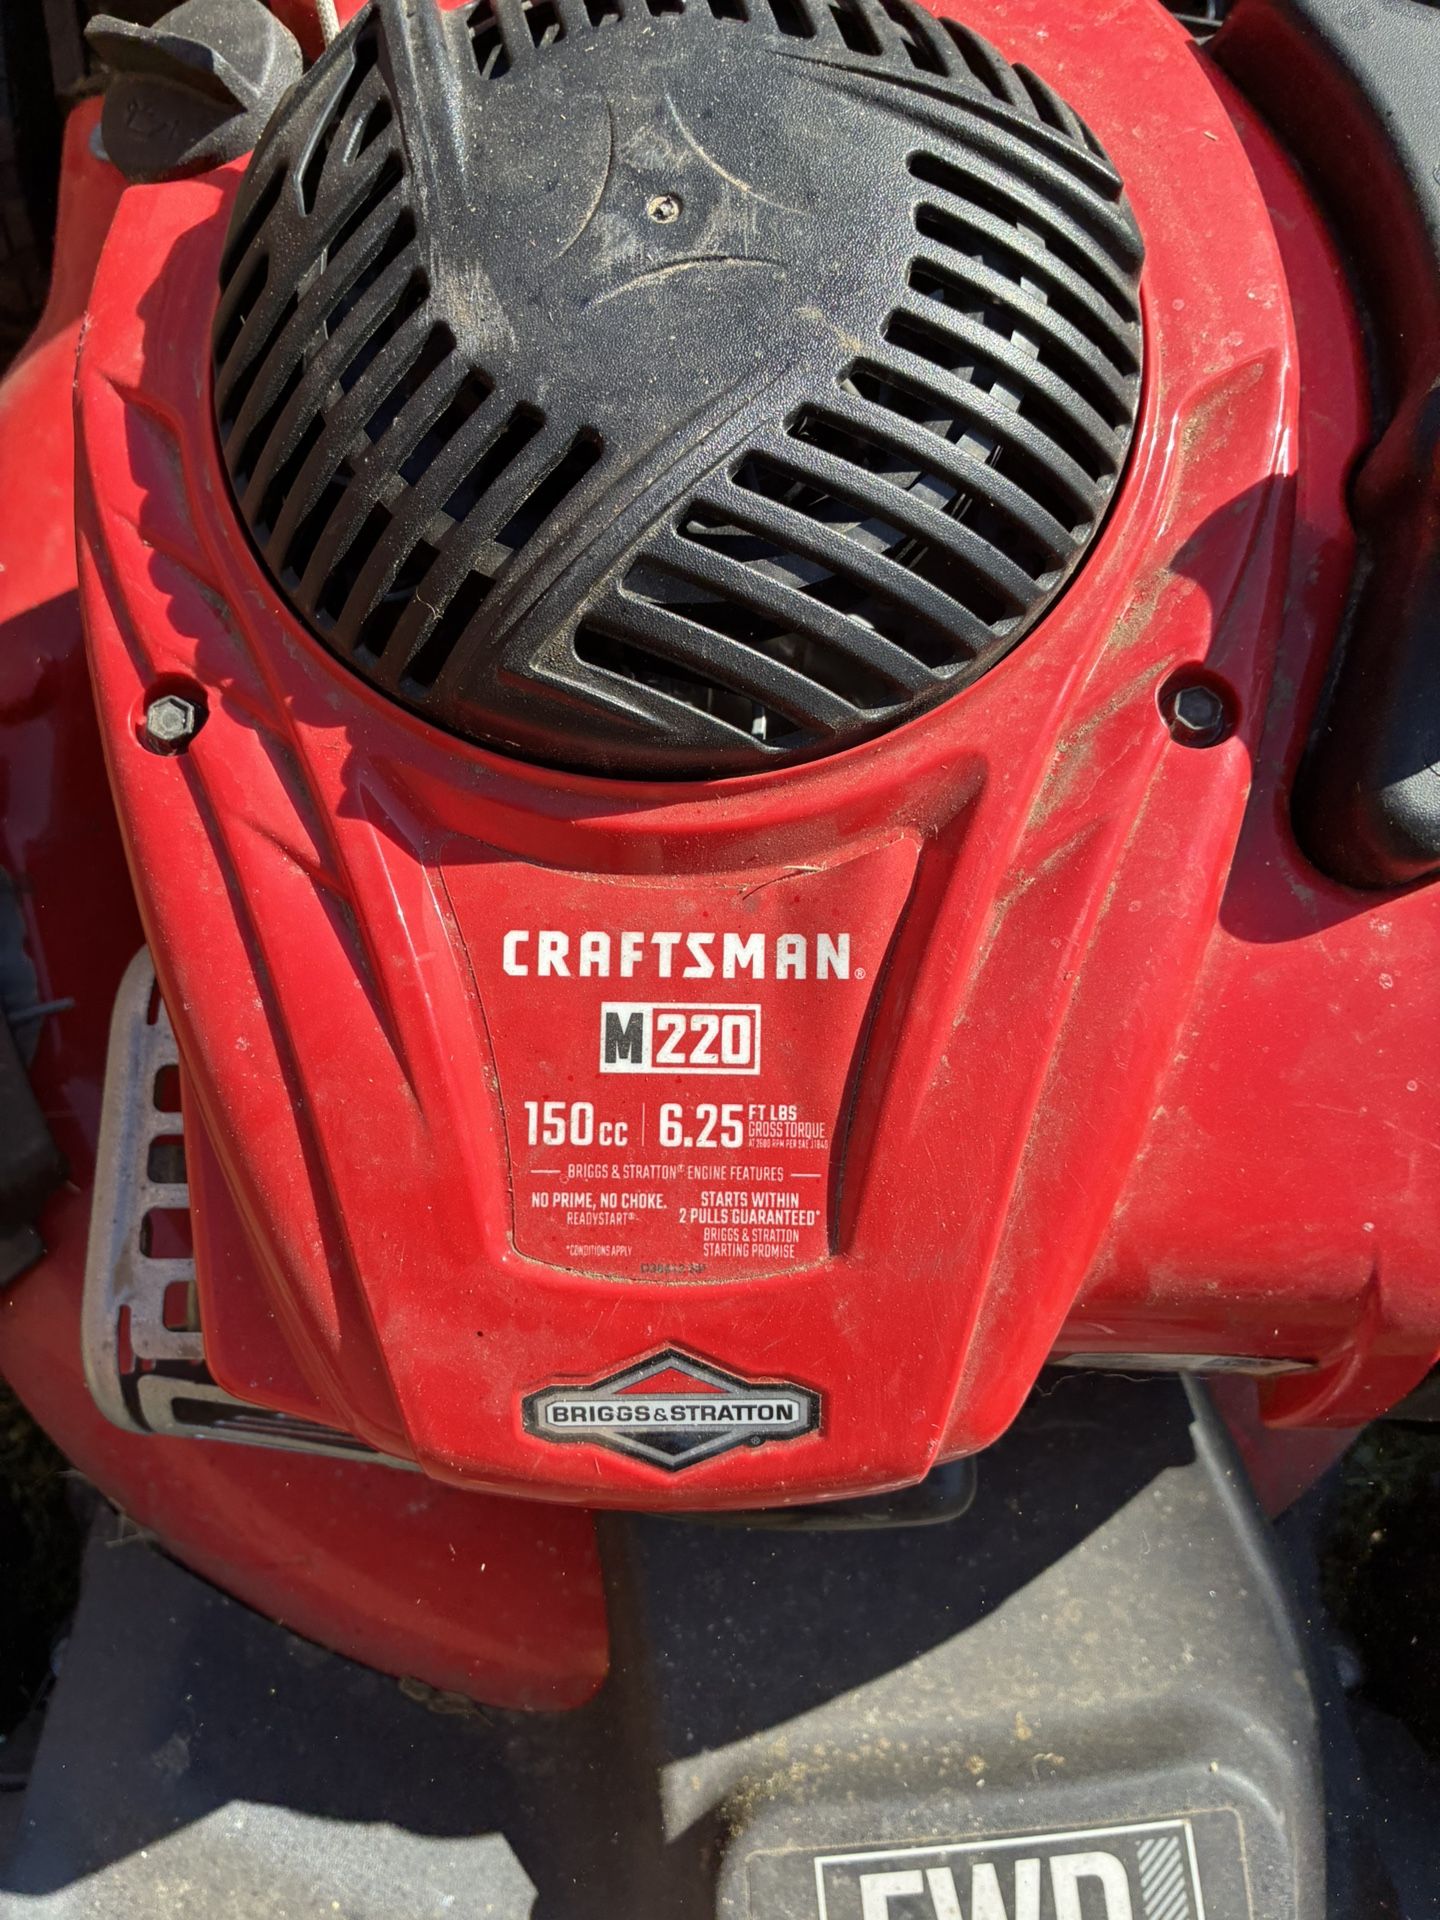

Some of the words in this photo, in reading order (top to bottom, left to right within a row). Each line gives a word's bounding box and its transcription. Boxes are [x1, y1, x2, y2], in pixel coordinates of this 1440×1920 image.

[748, 1104, 766, 1121] FT
[770, 1104, 797, 1122] LBS
[659, 1103, 743, 1148] 6.25
[748, 1121, 783, 1138] GROSS
[784, 1121, 826, 1139] TORQUE
[567, 1163, 609, 1178] BRIGGS
[611, 1165, 621, 1179] &
[687, 1165, 727, 1180] ENGINE
[730, 1166, 784, 1181] FEATURES
[531, 1191, 549, 1208] NO
[552, 1191, 597, 1210] PRIME,
[600, 1193, 617, 1209] NO
[621, 1193, 667, 1209] CHOKE.
[701, 1191, 748, 1207] STARTS
[751, 1191, 799, 1208] WITHIN
[679, 1207, 687, 1223] 2
[690, 1208, 728, 1224] PULLS
[703, 1227, 739, 1242] BRIGGS
[741, 1228, 750, 1242] &
[752, 1228, 799, 1243] STRATTON
[611, 1244, 633, 1257] APPLY
[703, 1242, 749, 1257] STARTING
[751, 1243, 795, 1258] PROMISE
